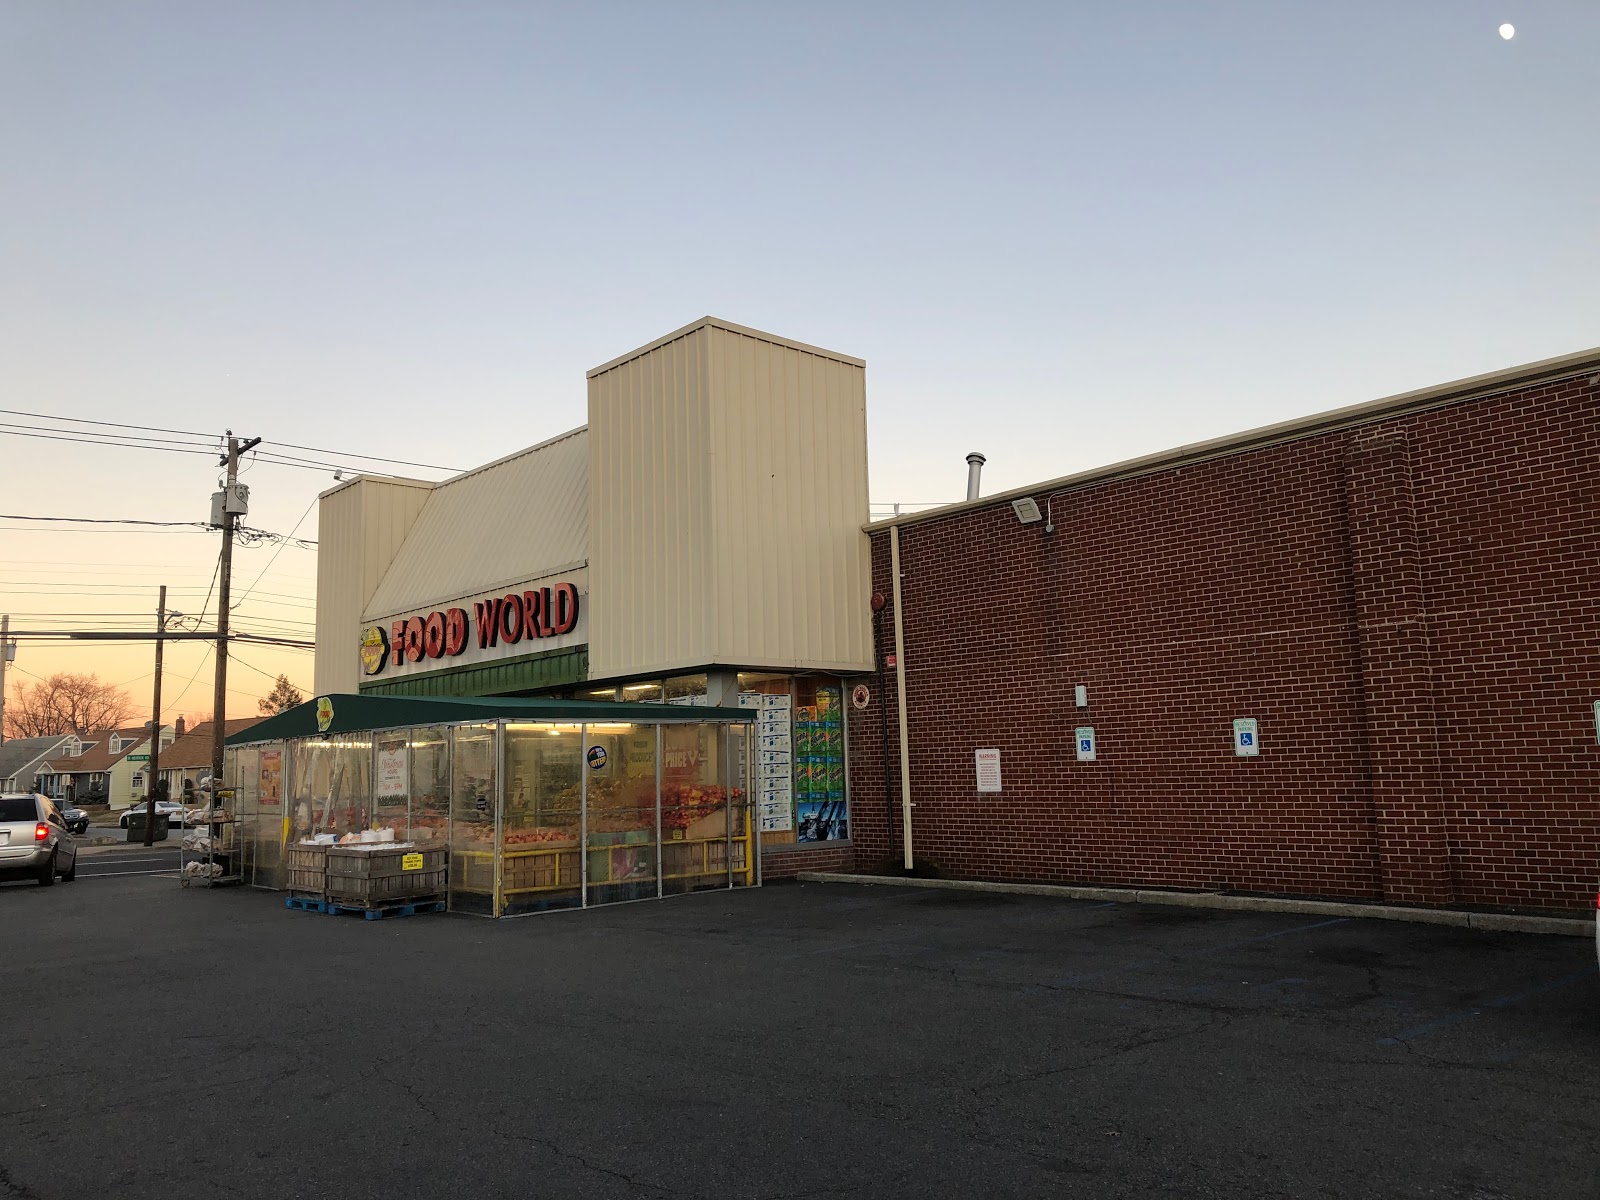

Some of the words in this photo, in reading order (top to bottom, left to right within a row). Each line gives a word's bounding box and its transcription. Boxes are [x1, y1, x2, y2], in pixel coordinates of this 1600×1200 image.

[392, 607, 469, 665] FOOD
[474, 582, 579, 649] WORLD
[666, 751, 687, 768] PRICE
